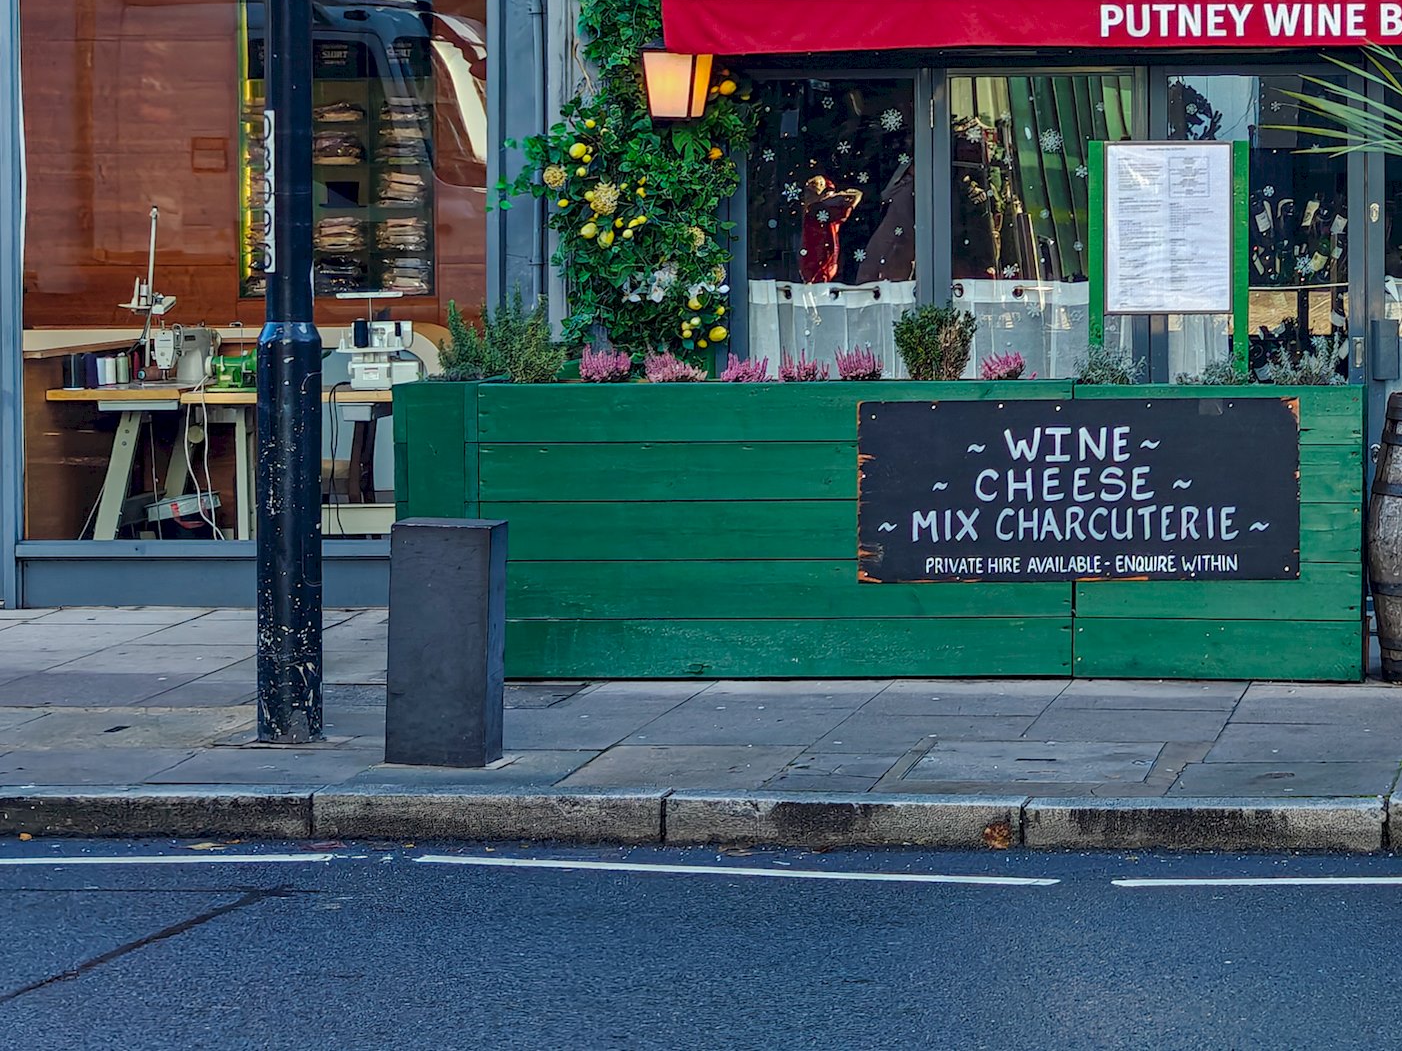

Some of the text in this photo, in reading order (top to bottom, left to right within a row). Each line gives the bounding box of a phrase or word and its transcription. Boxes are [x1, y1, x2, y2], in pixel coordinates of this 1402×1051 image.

[1100, 3, 1253, 38] PUTNEY
[1264, 3, 1366, 37] WINE
[1004, 425, 1132, 462] WINE
[975, 465, 1154, 502] CHEESE
[911, 505, 1240, 543] MIX CHARCUTERIE
[925, 556, 984, 574] PRIVATE
[988, 556, 1021, 574] HIRE
[1026, 555, 1102, 573] AVAILABLE
[1116, 555, 1175, 573] ENQUIRE
[1181, 554, 1239, 573] WITHIN
